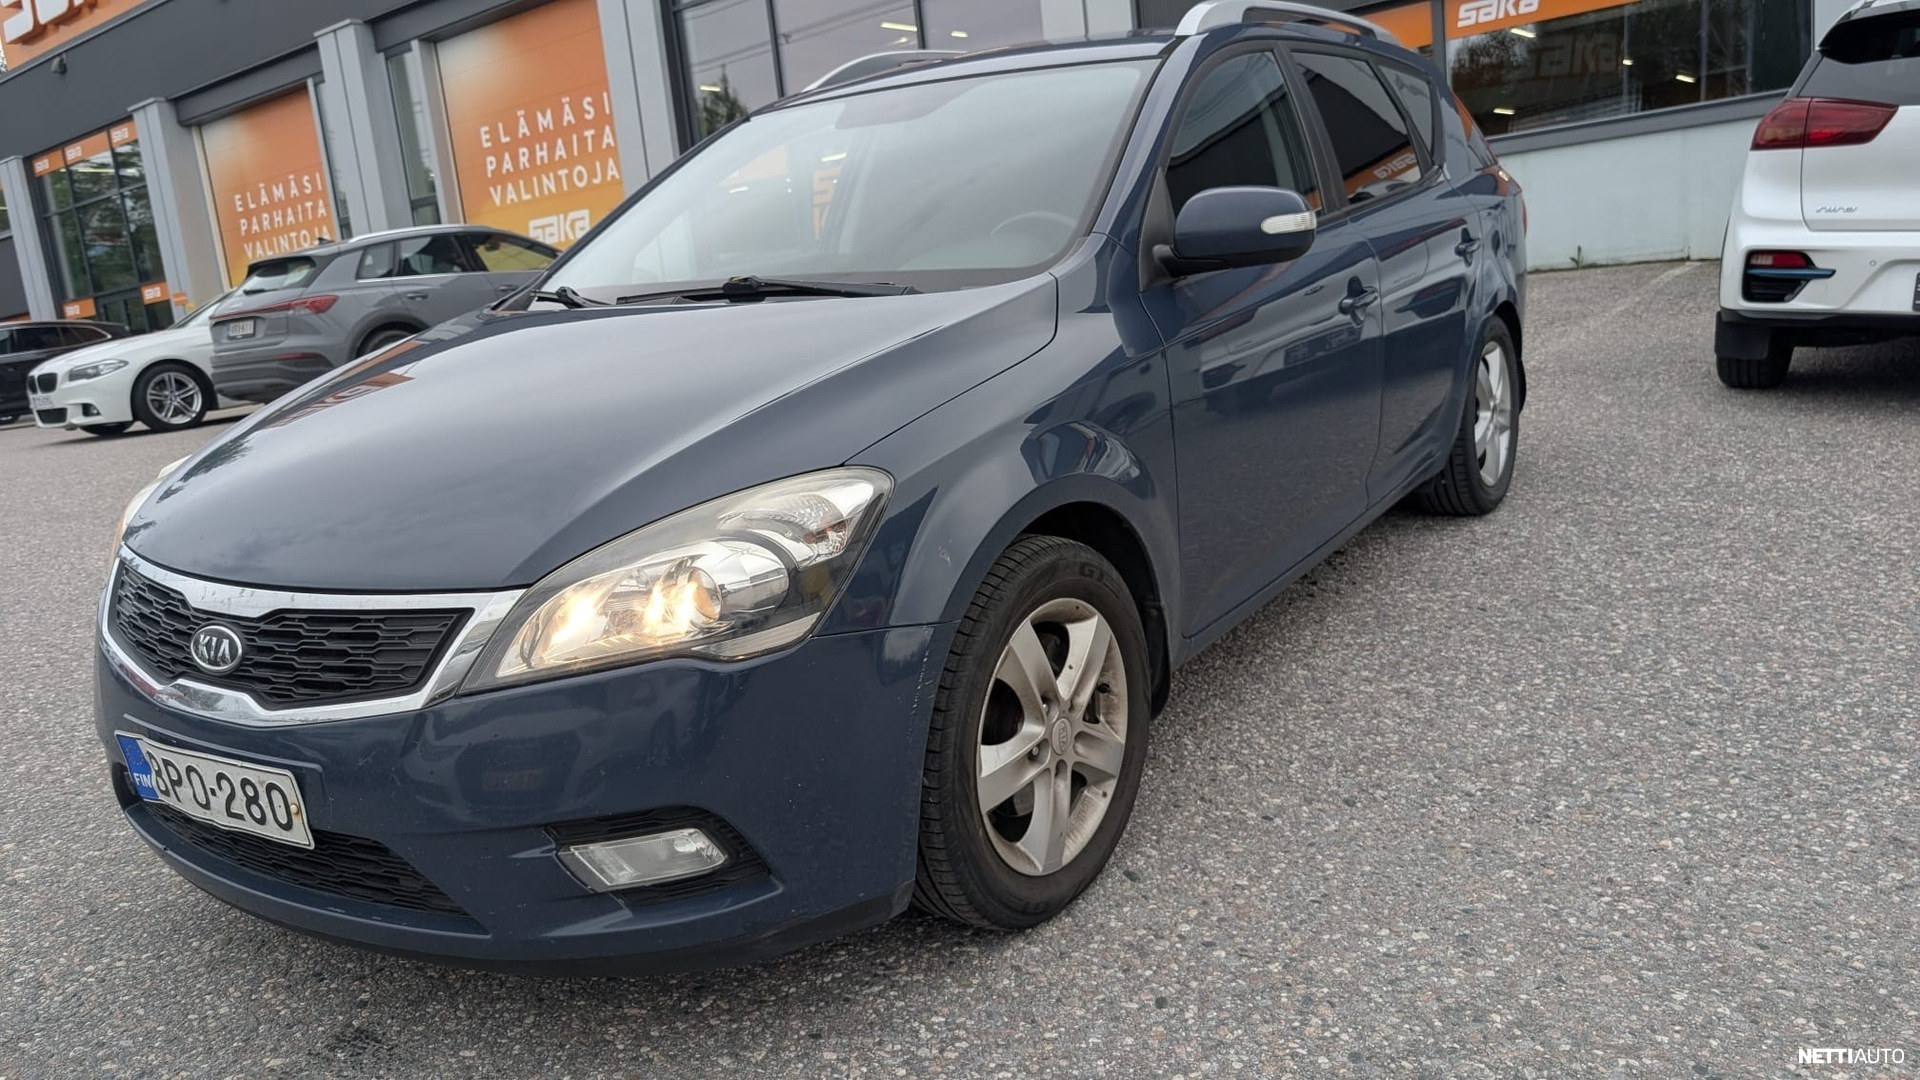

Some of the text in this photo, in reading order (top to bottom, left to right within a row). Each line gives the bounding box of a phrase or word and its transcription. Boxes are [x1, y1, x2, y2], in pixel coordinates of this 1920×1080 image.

[480, 91, 610, 148] ELÄMÄSI
[486, 125, 615, 178] PARHAITA
[234, 172, 322, 212] ELÄMÄSI
[489, 158, 621, 206] VALINTOJA
[240, 199, 327, 236] PARHAITA
[243, 225, 332, 260] VALINTOJA
[199, 632, 231, 667] KIA
[133, 772, 153, 789] FIN
[146, 750, 294, 832] BPO-280
